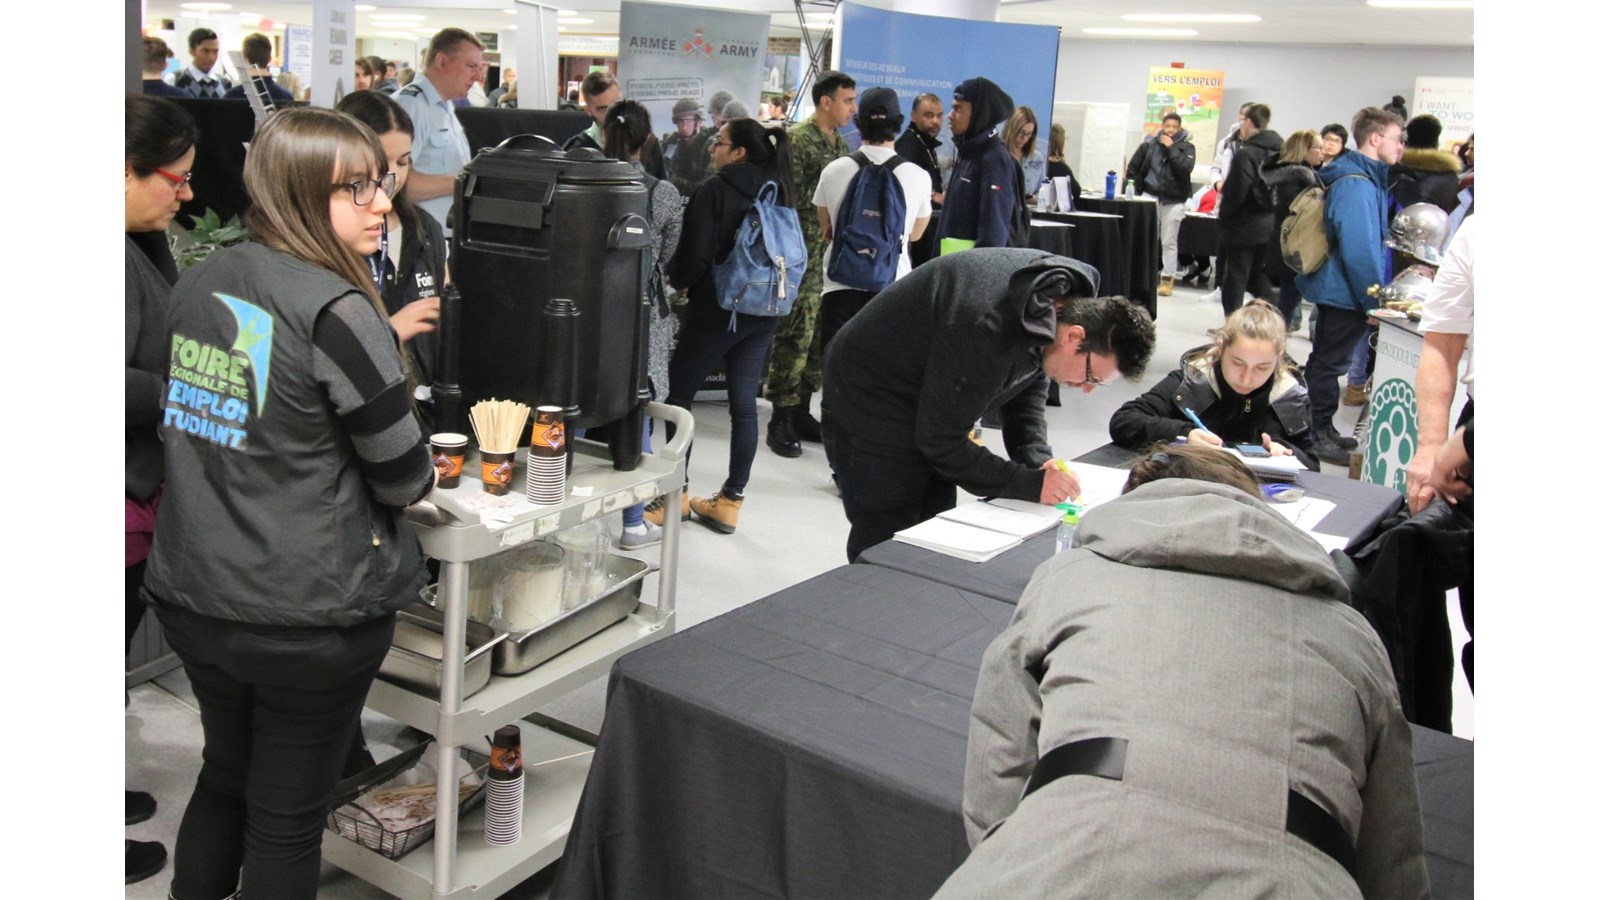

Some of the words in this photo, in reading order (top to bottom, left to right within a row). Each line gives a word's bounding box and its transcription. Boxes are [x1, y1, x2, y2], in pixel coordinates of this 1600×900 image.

[629, 36, 676, 50] ARMÉE
[720, 44, 758, 57] ARMY
[879, 63, 906, 74] RÉSEAUX
[877, 75, 884, 84] ET
[885, 76, 893, 85] DE
[895, 77, 952, 89] COMMUNICATION
[1153, 75, 1177, 83] VERS
[1180, 76, 1221, 86] L'EMPLOI
[1427, 101, 1456, 110] WANT
[171, 334, 249, 386] FOIRE
[170, 361, 228, 393] ÉGIONALE
[230, 385, 248, 400] DE
[705, 372, 726, 382] nada
[167, 379, 249, 424] 'EMPLOI
[163, 407, 248, 448] TUDIANT
